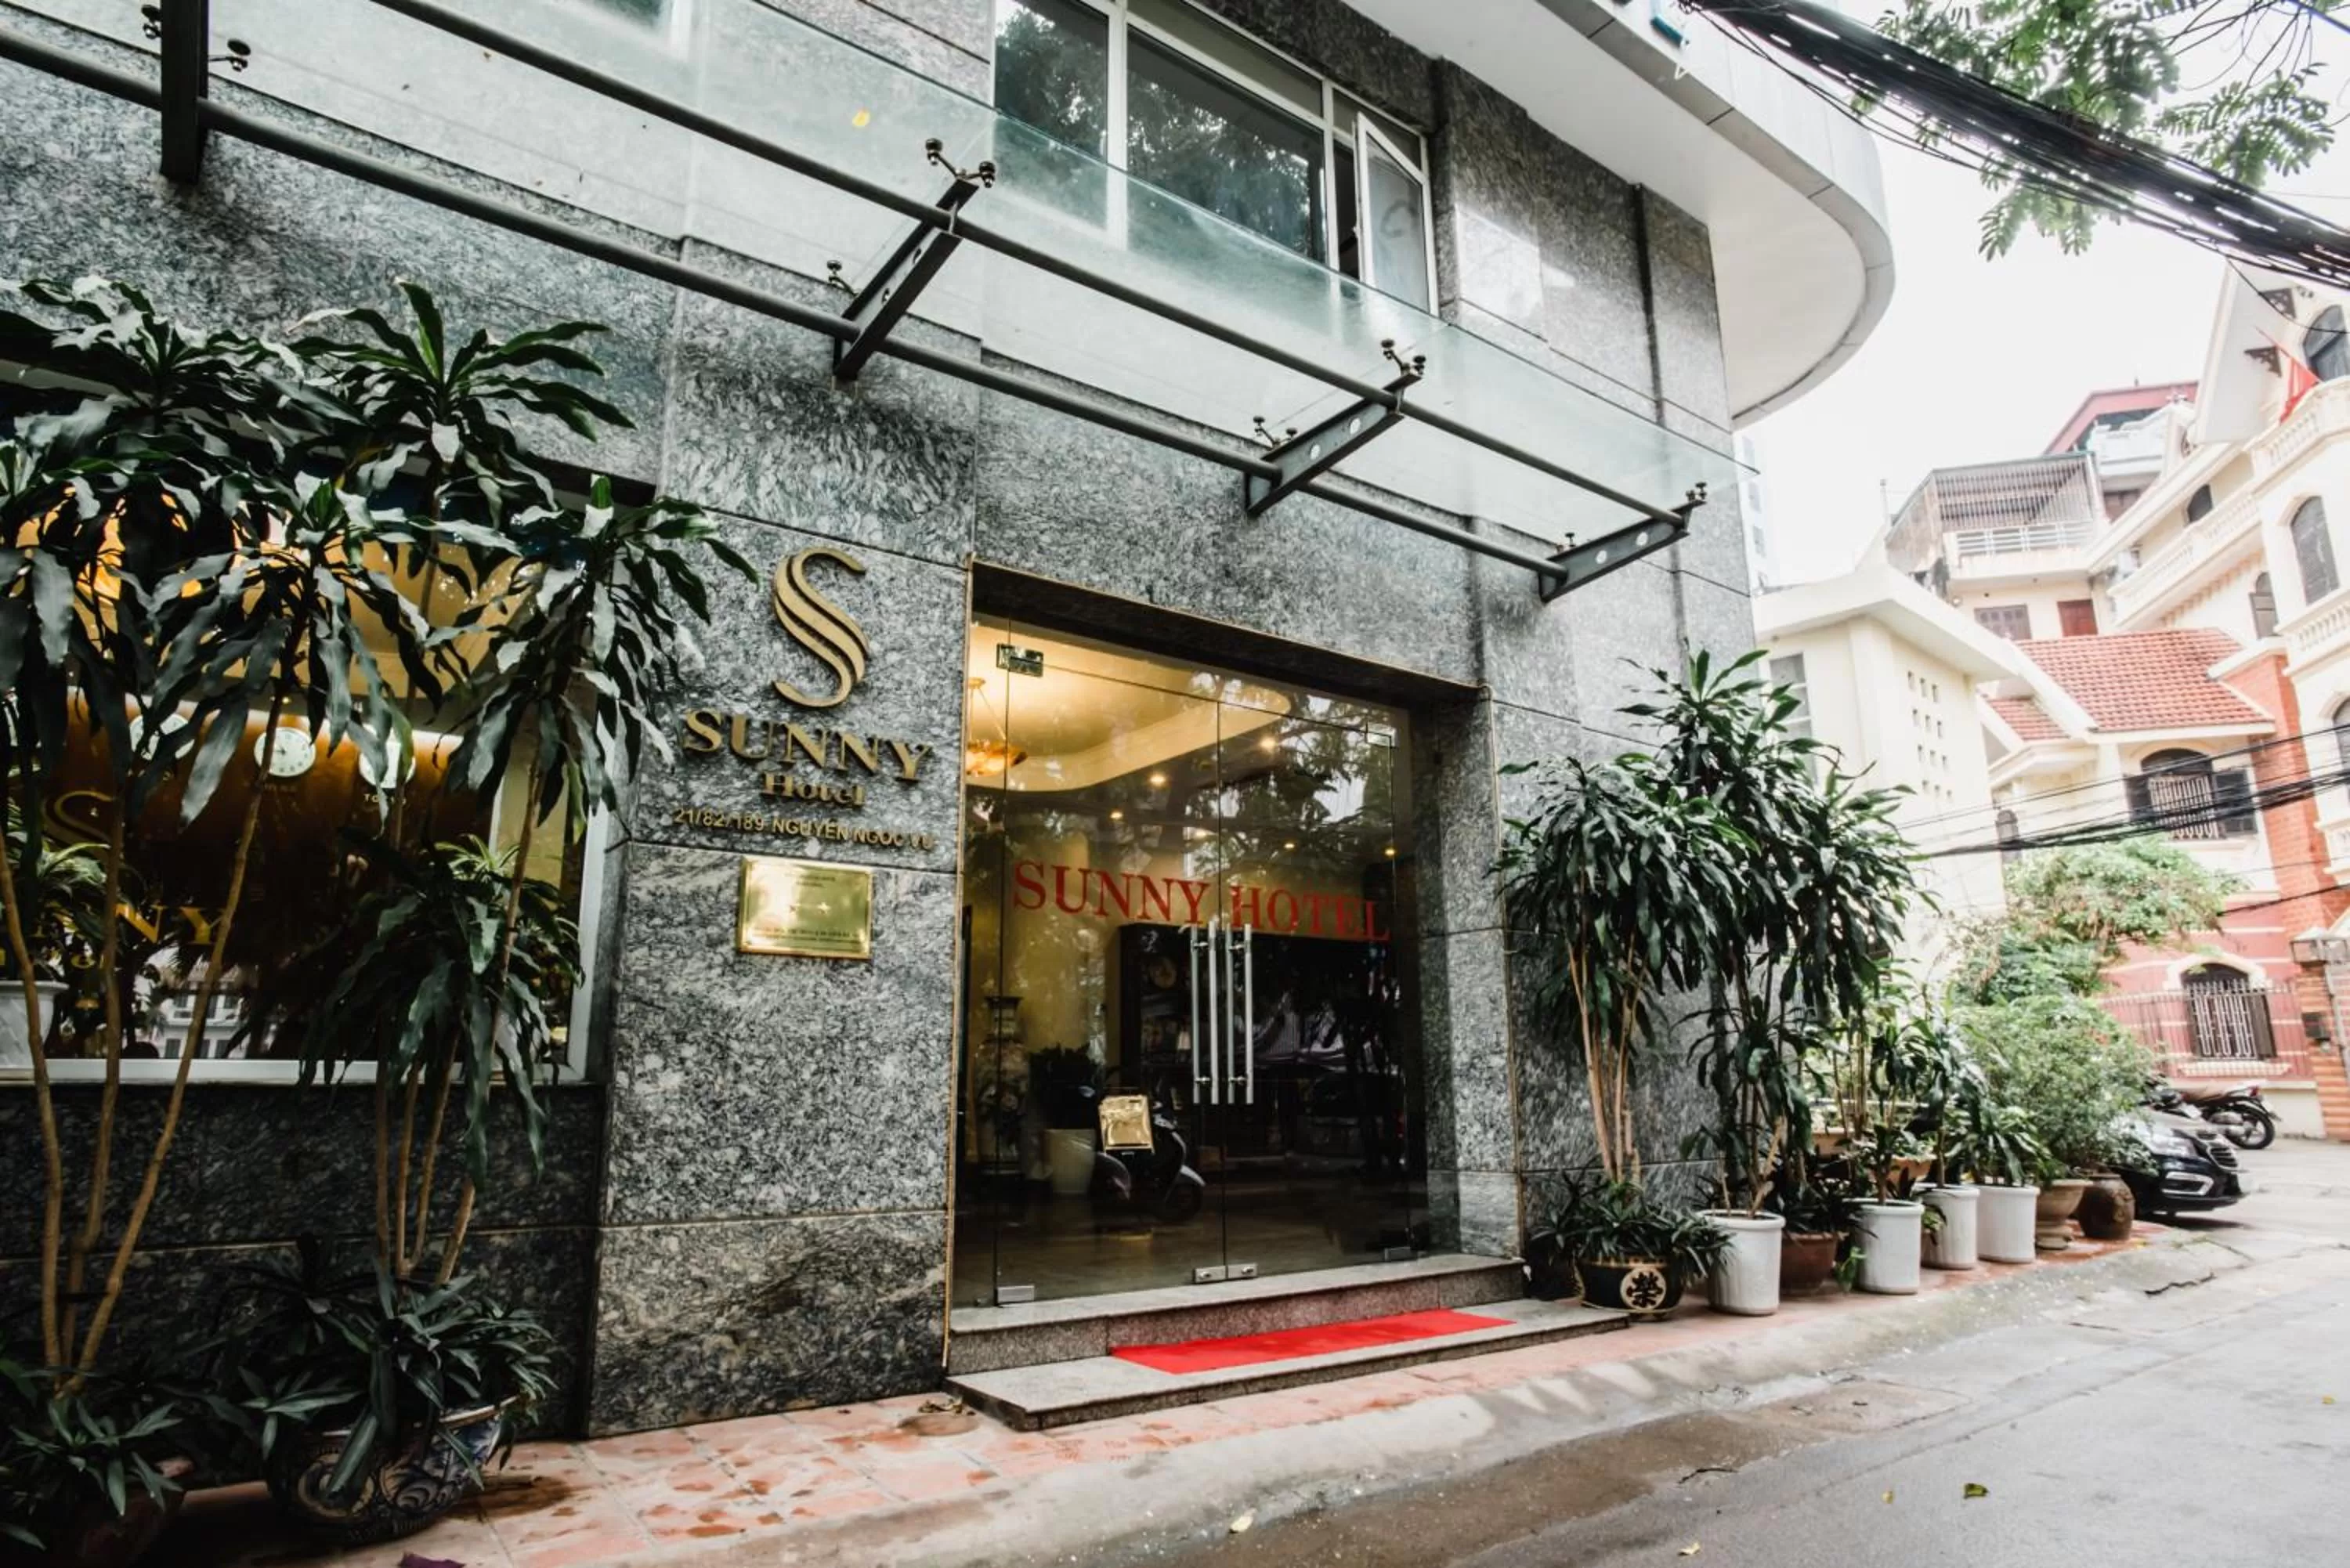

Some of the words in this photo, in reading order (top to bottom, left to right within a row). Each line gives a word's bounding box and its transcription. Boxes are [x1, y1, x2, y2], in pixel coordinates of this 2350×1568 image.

[682, 706, 932, 783] SUNNY
[674, 807, 765, 832] 21/82/189
[760, 771, 866, 810] Hotel
[1014, 859, 1210, 925] SUNNY
[1227, 885, 1390, 943] HOTEL
